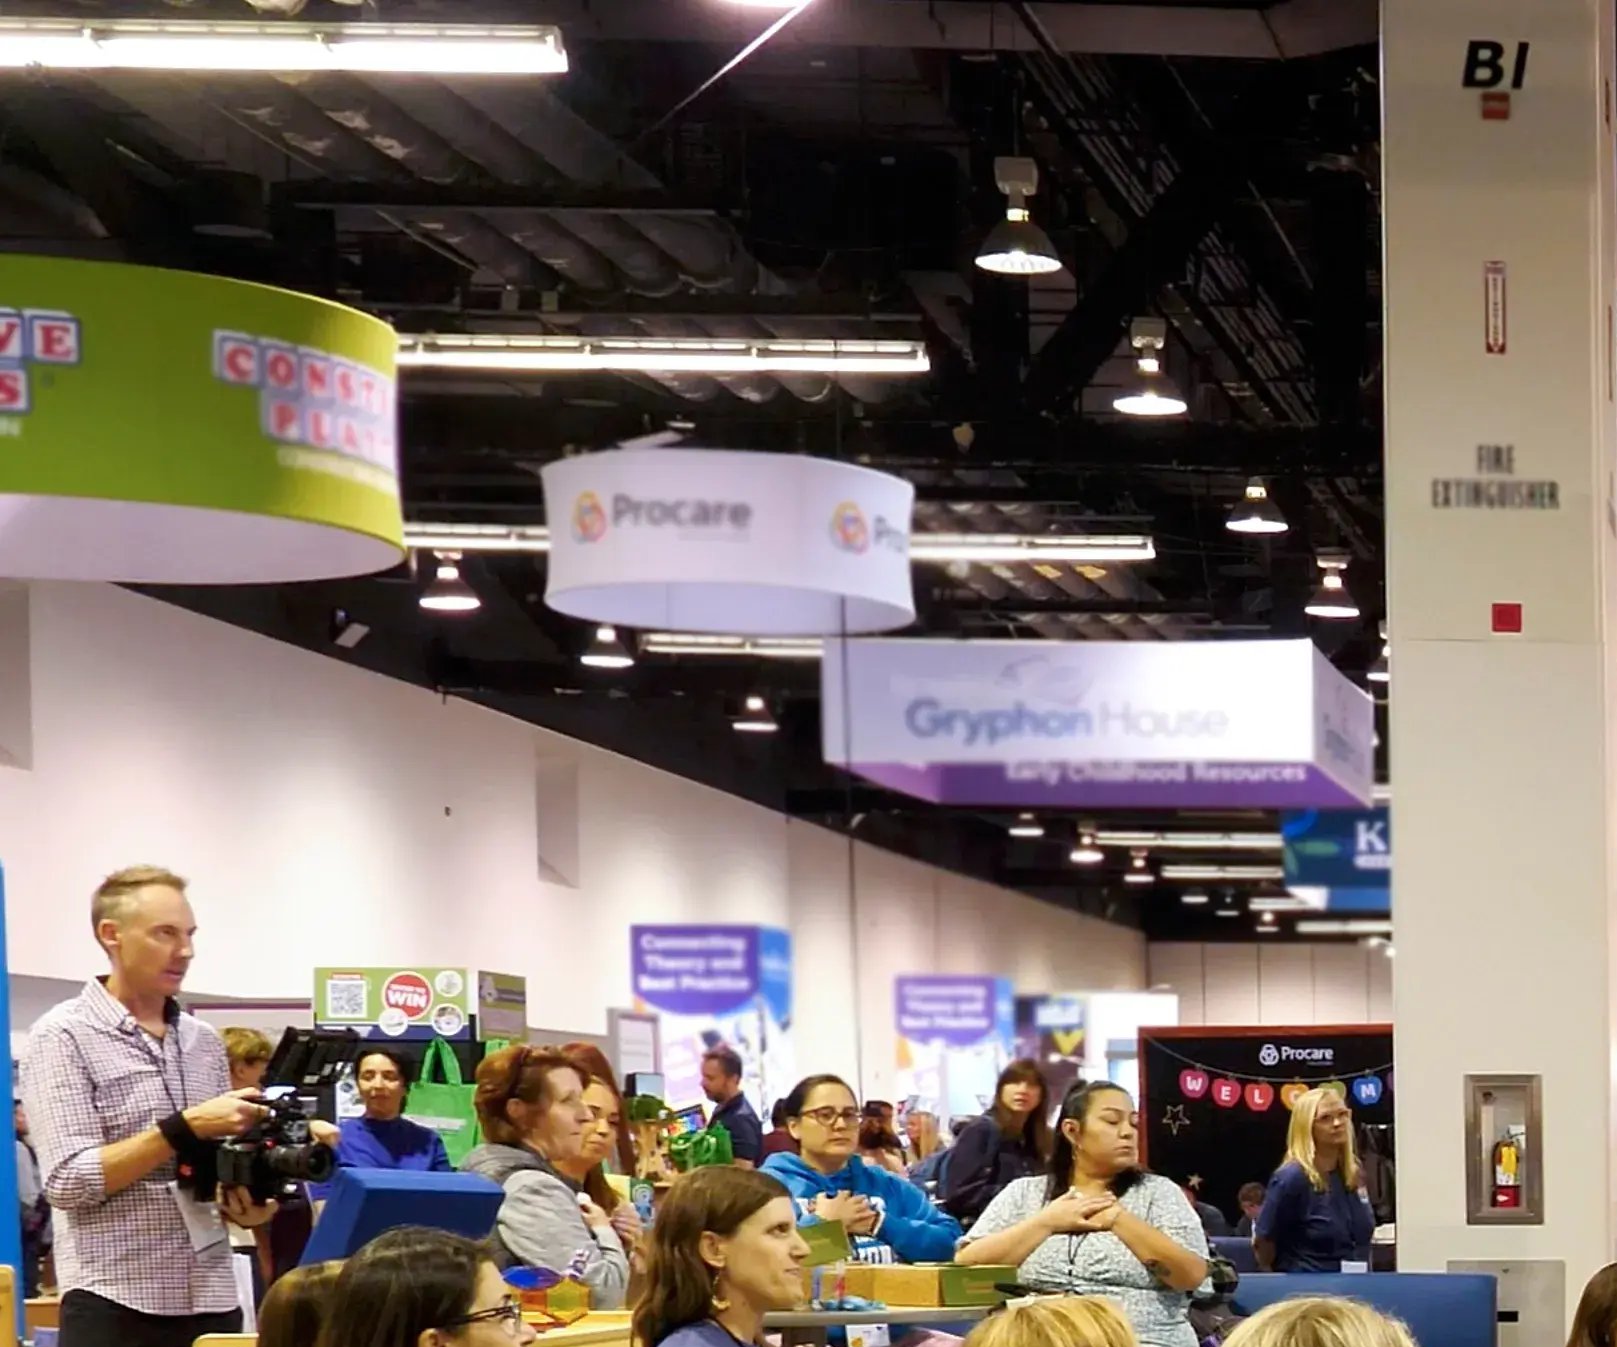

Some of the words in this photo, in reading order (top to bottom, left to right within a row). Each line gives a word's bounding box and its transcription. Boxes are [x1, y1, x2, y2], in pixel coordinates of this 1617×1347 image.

[1476, 444, 1515, 475] FIRE
[1431, 478, 1560, 510] EXTINGUISHER
[612, 493, 753, 529] Procare
[904, 697, 1094, 746] Gryphon
[1098, 701, 1229, 739] House
[1193, 761, 1307, 782] Resources
[638, 974, 677, 990] Best
[680, 975, 750, 991] Practice
[387, 988, 428, 1008] WIN
[1281, 1046, 1334, 1061] Procare
